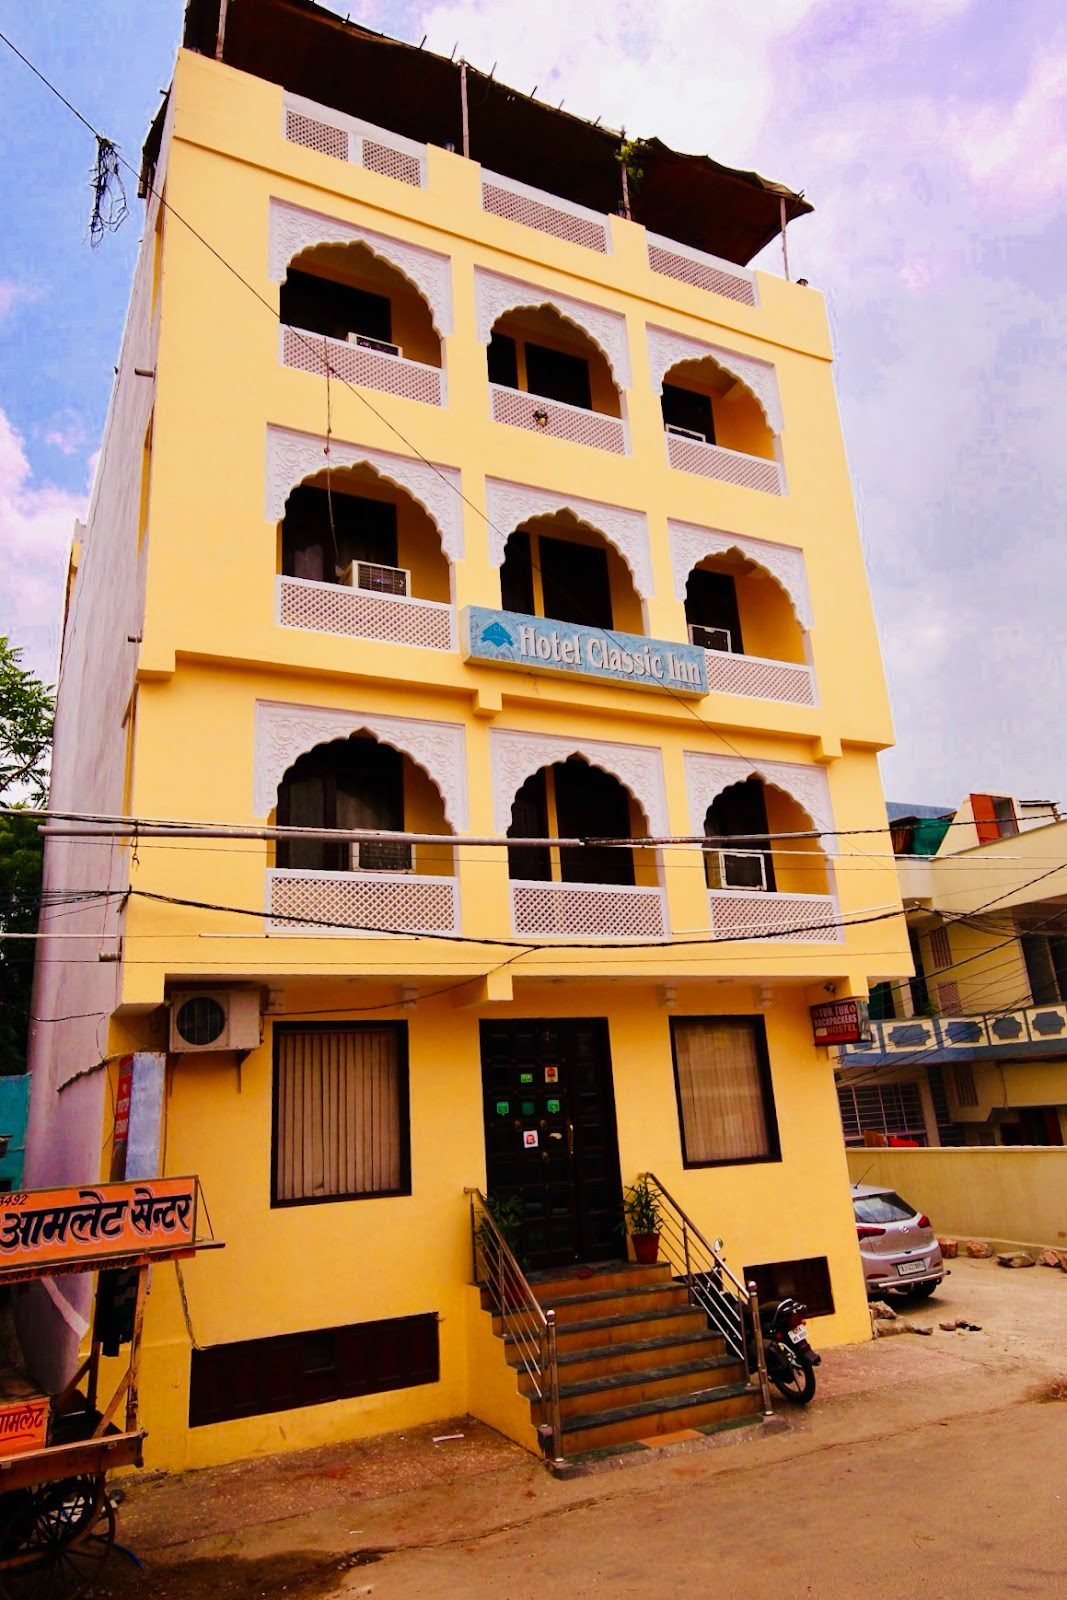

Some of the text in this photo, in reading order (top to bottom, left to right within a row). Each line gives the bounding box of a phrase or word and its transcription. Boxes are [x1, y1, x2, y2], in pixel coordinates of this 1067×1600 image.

[519, 625, 702, 685] Hotel Classic Inn
[835, 1004, 849, 1015] TUK
[814, 1013, 857, 1027] BACKPACKERS
[827, 1023, 857, 1034] HOSTEL
[0, 1190, 129, 1249] आमलेट
